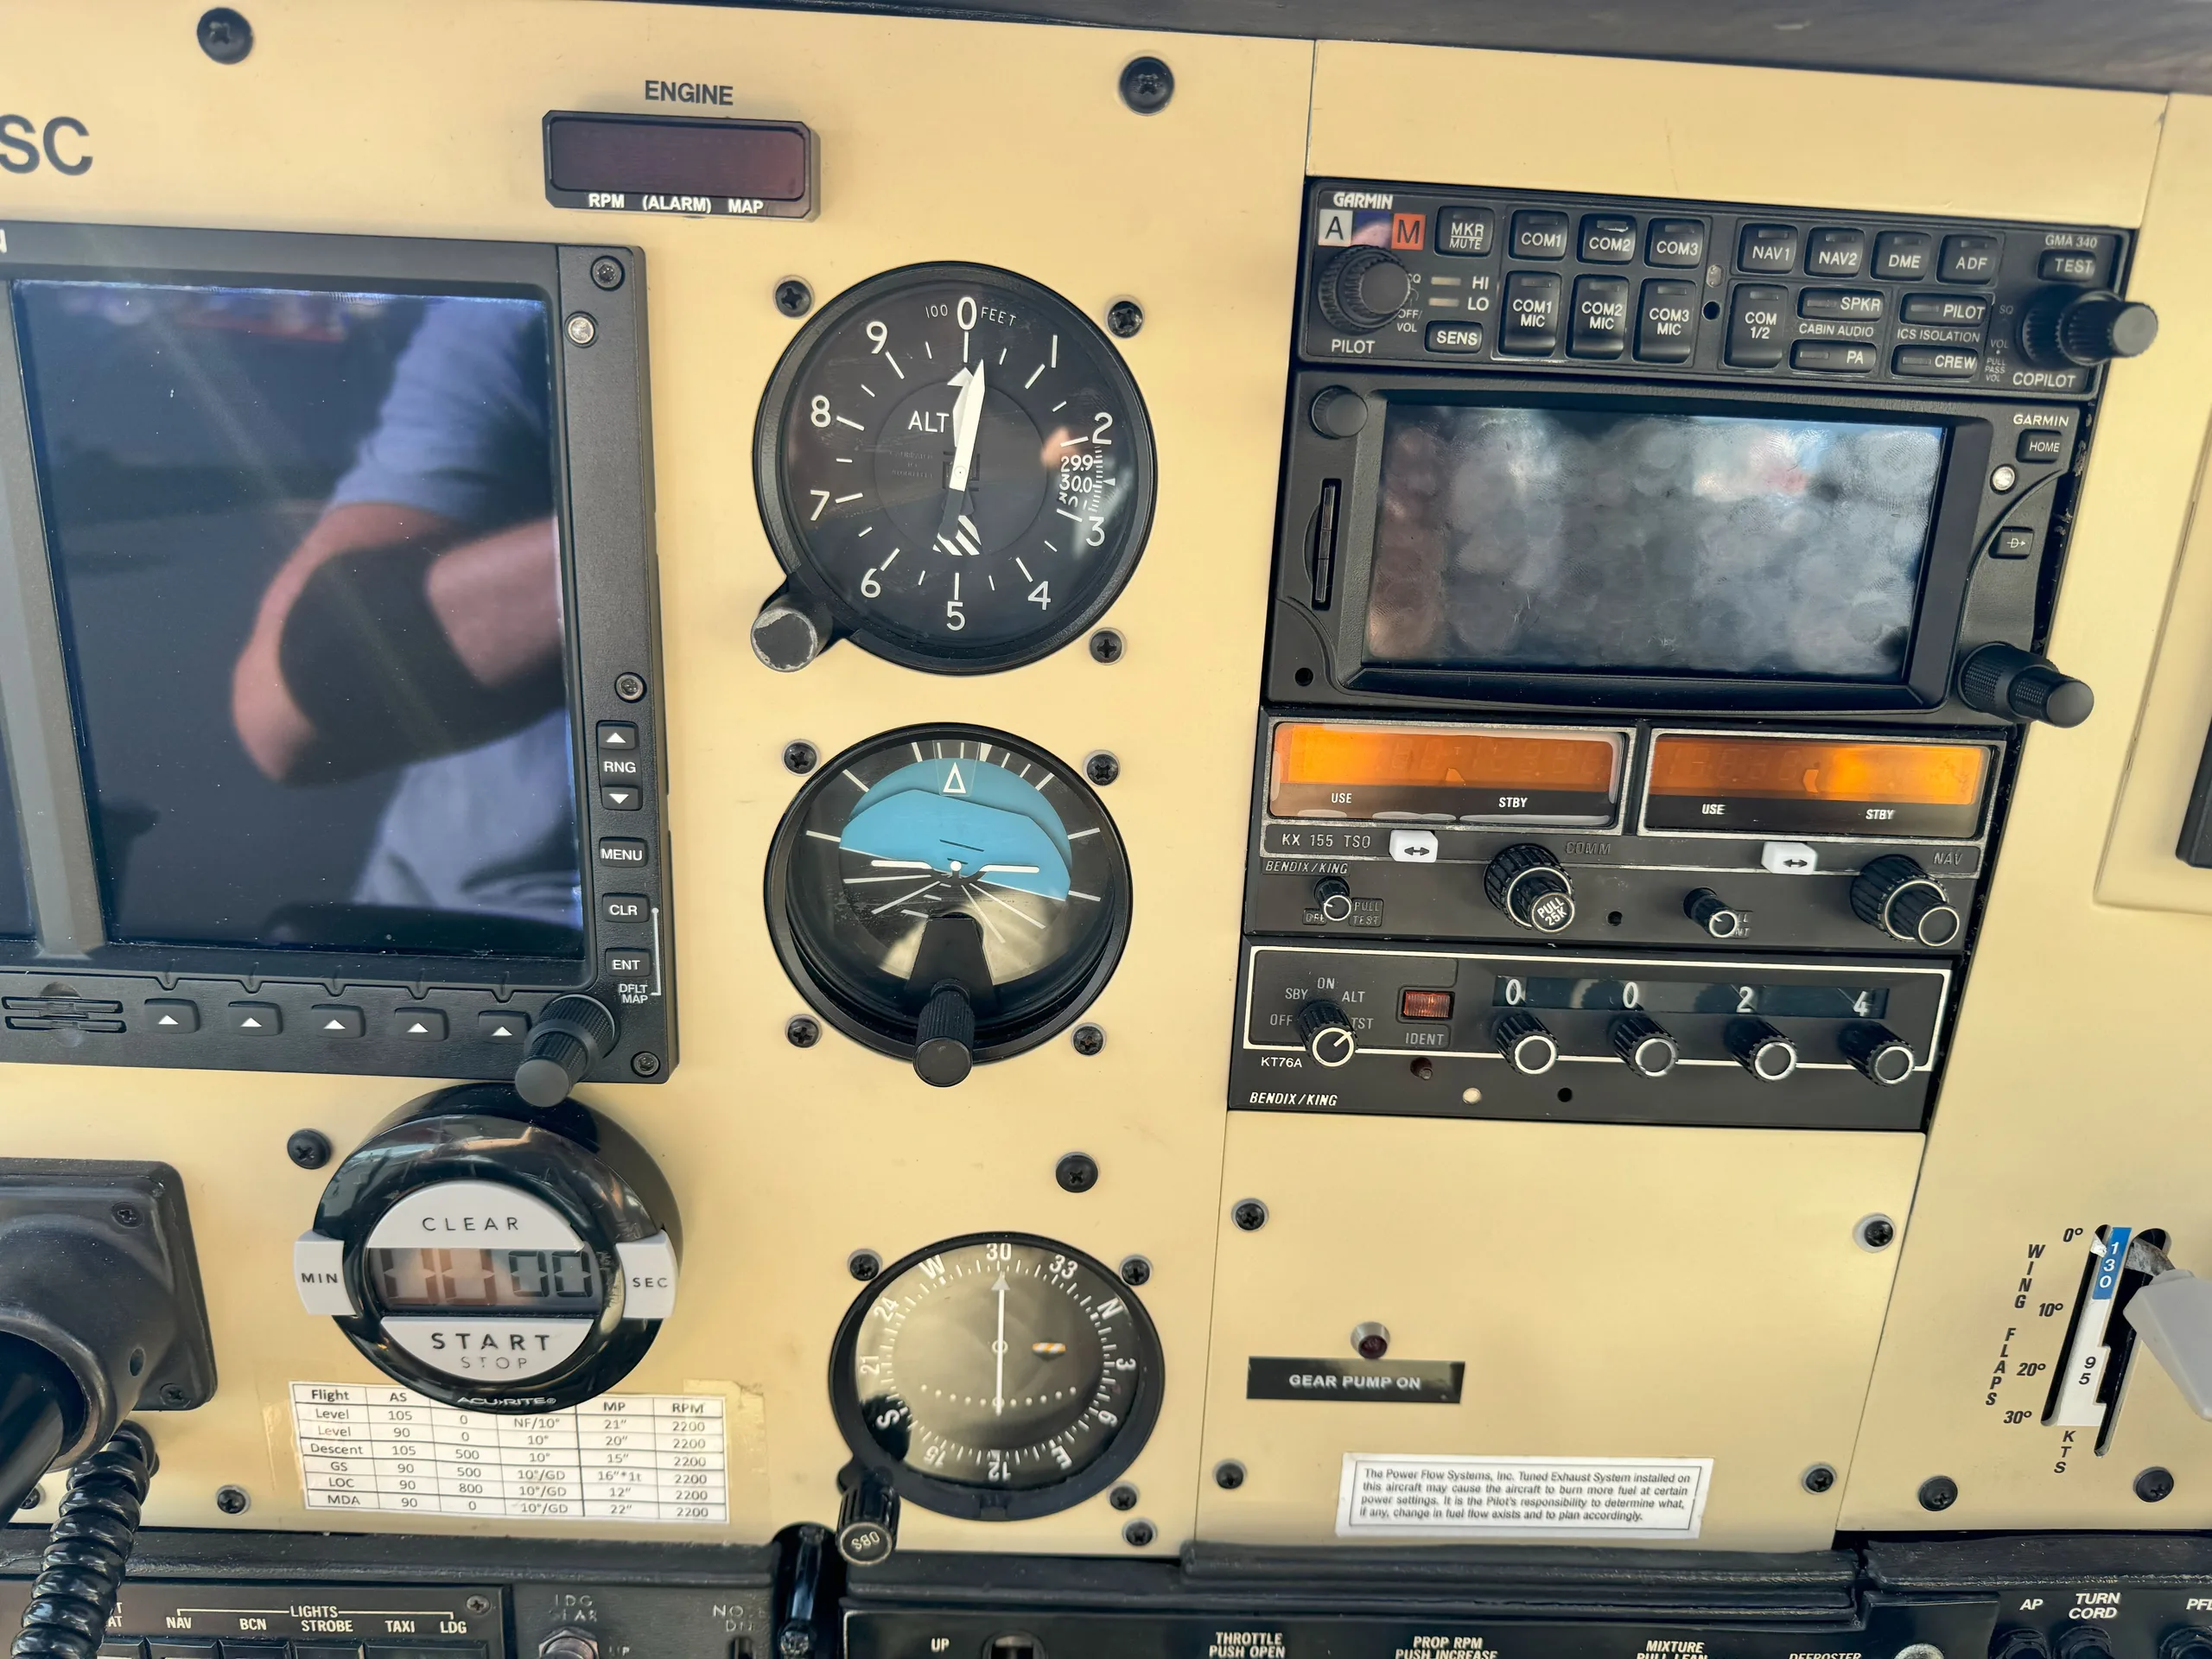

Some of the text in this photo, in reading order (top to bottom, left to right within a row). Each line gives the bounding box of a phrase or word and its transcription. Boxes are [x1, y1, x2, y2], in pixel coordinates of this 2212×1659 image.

[645, 79, 734, 105] ENGINE
[0, 114, 93, 176] SC
[588, 192, 764, 214] RPM (ALARM) MAP
[1333, 192, 1393, 210] GARMIN
[1325, 216, 1344, 241] A
[1397, 219, 1420, 244] M
[1451, 222, 1484, 238] MKR
[1448, 237, 1482, 251] MUTE
[1521, 232, 1562, 248] COM1
[1589, 237, 1631, 253] COM2
[2044, 234, 2098, 250] GMA 340
[1656, 240, 1699, 257] COM3
[1751, 245, 1790, 262] NAV1
[1818, 250, 1858, 266] NAV2
[1888, 253, 1922, 270] DME
[1955, 256, 1988, 271] ADF
[2054, 258, 2094, 275] TEST
[1471, 276, 1490, 291] HI
[1467, 296, 1490, 312] LO
[1512, 298, 1553, 315] COM1
[1581, 301, 1623, 317] COM2
[1840, 296, 1882, 313] SPKR
[925, 296, 1017, 331] 100 0 FEET
[1649, 308, 1690, 323] COM3
[1744, 311, 1777, 327] COM
[1942, 303, 1986, 321] PILOT
[1396, 322, 1417, 333] VOL
[1520, 313, 1546, 328] MIC
[1589, 315, 1614, 331] MIC
[1656, 321, 1681, 337] MIC
[1750, 325, 1770, 340] 1/2
[1799, 322, 1874, 338] CABIN AUDIO
[1897, 328, 1980, 343] ICS ISOLATION
[866, 321, 888, 354] 9
[1436, 330, 1478, 346] SENS
[1332, 339, 1376, 354] PILOT
[1846, 350, 1865, 365] PA
[1934, 354, 1977, 370] CREW
[2012, 372, 2076, 389] COPILOT
[810, 395, 832, 428] 8
[907, 410, 950, 433] ALT
[1092, 411, 1113, 445] 2
[2012, 414, 2069, 427] GARMIN
[2029, 441, 2060, 454] HOME
[810, 490, 830, 521] 7
[1085, 516, 1105, 547] 3
[861, 568, 882, 598] 6
[1028, 581, 1052, 611] 4
[946, 601, 966, 631] 5
[603, 760, 637, 774] RNG
[1331, 791, 1352, 804] USE
[1498, 796, 1529, 809] STBY
[1701, 803, 1726, 816] USE
[1866, 808, 1895, 820] STBY
[1281, 833, 1371, 849] KX 155 TSO
[1565, 840, 1612, 856] COMM
[600, 848, 643, 861] MENU
[1934, 851, 1963, 866] NAV
[1265, 860, 1349, 875] BENDIX/KING
[608, 904, 638, 917] CLR
[613, 958, 640, 970] ENT
[619, 983, 648, 994] DFLT
[1317, 977, 1335, 990] ON
[622, 993, 648, 1004] MAP
[1285, 988, 1308, 1001] SBY
[1341, 990, 1365, 1004] ALT
[1270, 1014, 1293, 1027] OFF
[1351, 1017, 1374, 1030] TST
[1405, 1033, 1445, 1046] IDENT
[1261, 1056, 1303, 1069] KT76A
[1249, 1090, 1338, 1107] BENDIX/KING
[422, 1217, 518, 1232] CLEAR
[986, 1243, 1012, 1261] 30
[1050, 1255, 1078, 1280] 33
[301, 1272, 338, 1285] MIN
[632, 1276, 668, 1289] SEC
[2014, 1244, 2045, 1309] WING
[432, 1333, 550, 1351] START
[461, 1356, 528, 1370] STOP
[1986, 1327, 2016, 1406] FLAPS
[1289, 1375, 1421, 1389] GEAR PUMP ON
[312, 1389, 704, 1414] Flight AS MP RPM
[315, 1408, 705, 1432] Level 105 2200
[318, 1426, 705, 1449] Level 90 2200
[310, 1443, 706, 1466] Descent 105 500 2200
[2054, 1430, 2075, 1473] KTS
[330, 1461, 707, 1484] GS 500 2200
[1386, 1469, 1417, 1479] Power
[1421, 1469, 1445, 1479] Flow
[1551, 1472, 1592, 1482] Exhaust
[1593, 1472, 1631, 1484] System
[1633, 1473, 1675, 1483] installed
[329, 1478, 708, 1501] LOC 800 2200
[1386, 1482, 1688, 1496] aircraft aircraft certain
[327, 1495, 709, 1517] MDA 90 2200
[1361, 1495, 1655, 1509] power settings. responsibility determine
[1393, 1508, 1643, 1522] change exists accordingly.
[2019, 1599, 2044, 1611] AP
[2075, 1592, 2120, 1605] TURN
[290, 1605, 339, 1618] LIGHTS
[2068, 1607, 2118, 1620] CORD
[166, 1617, 192, 1629] NAV
[239, 1618, 267, 1630] BCN
[301, 1619, 353, 1633] STROBE
[385, 1620, 416, 1633] TAXI
[440, 1621, 467, 1634] LDG
[931, 1638, 950, 1653] UP
[1216, 1631, 1282, 1646] THROTTLE
[1413, 1636, 1483, 1649] PROP RPM
[1210, 1645, 1286, 1658] PUSH OPEN
[1645, 1640, 1705, 1653] MIXTURE
